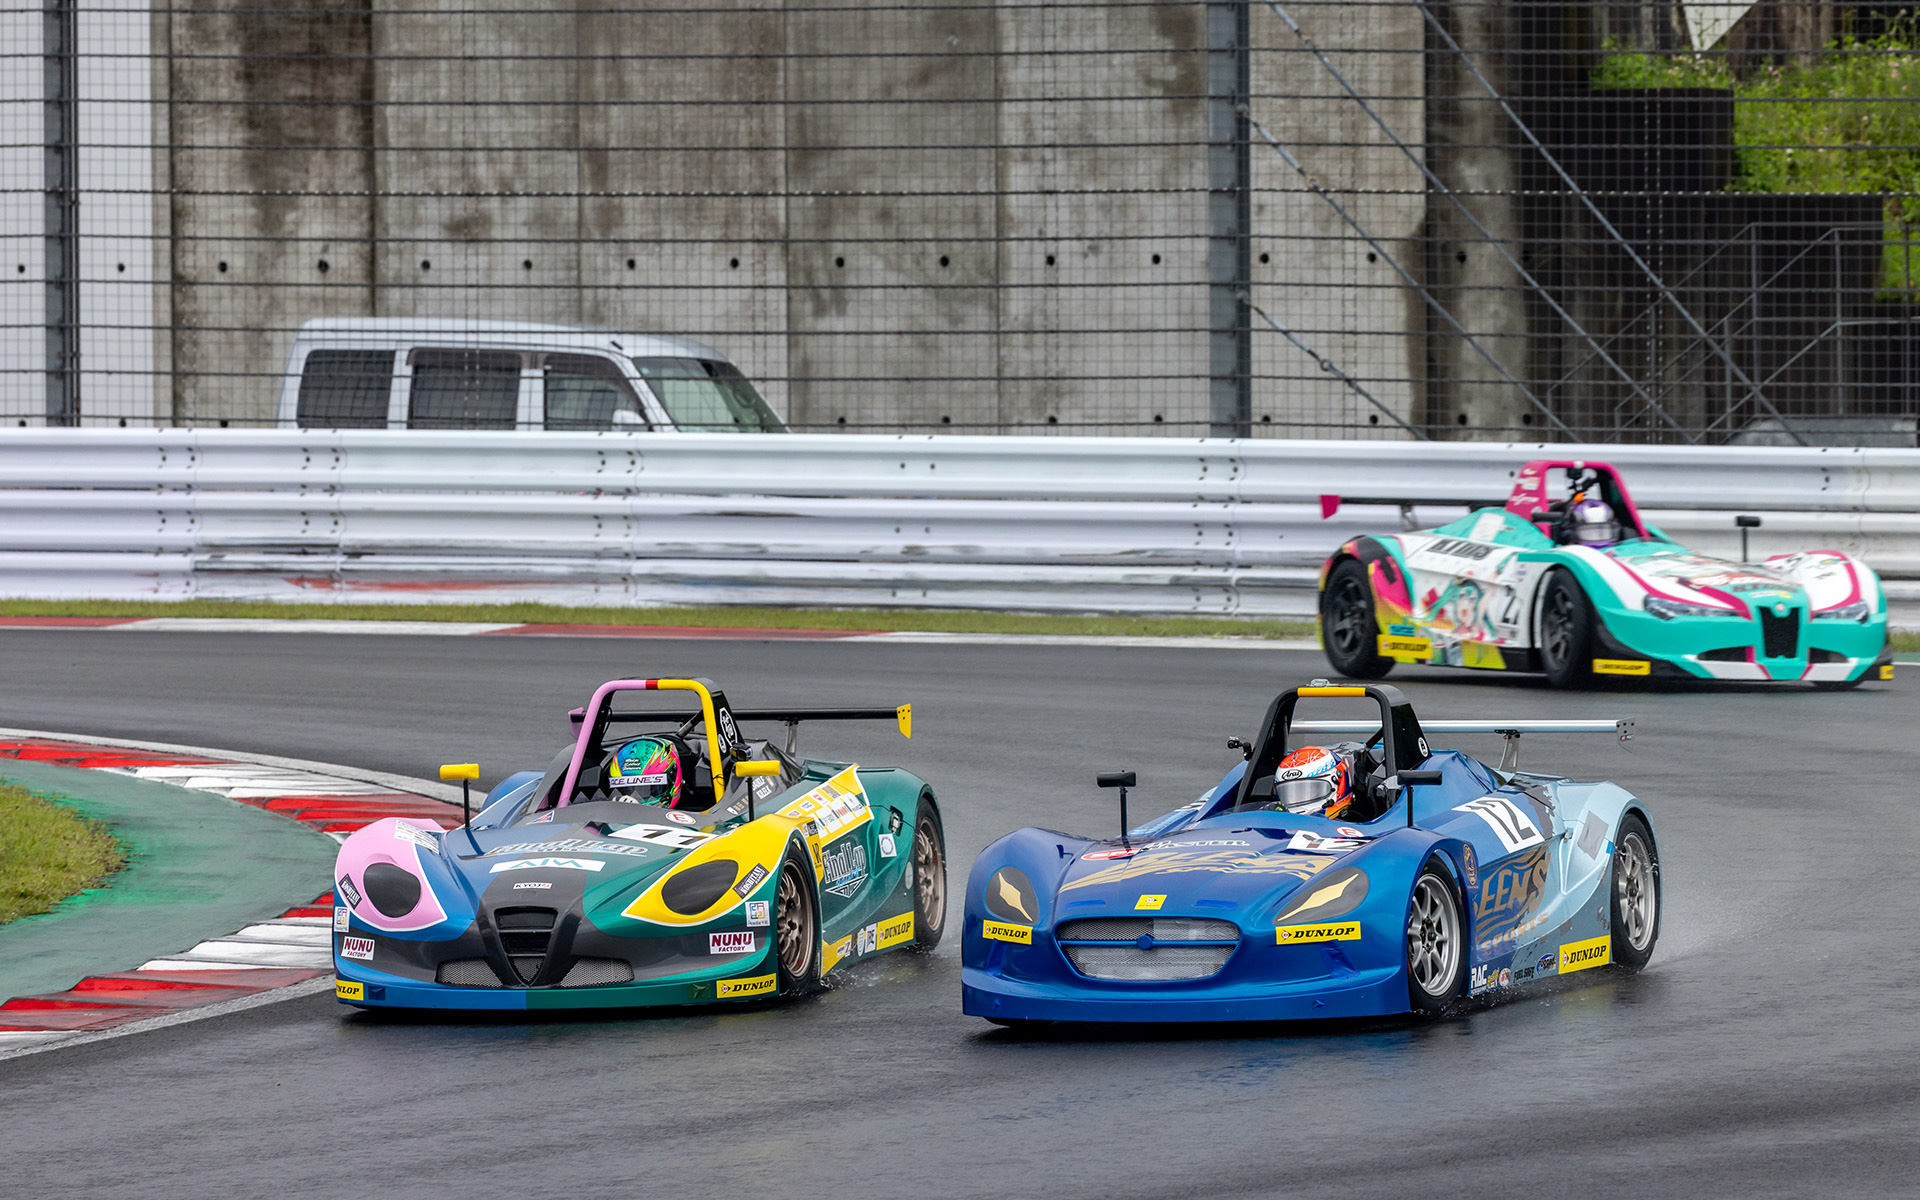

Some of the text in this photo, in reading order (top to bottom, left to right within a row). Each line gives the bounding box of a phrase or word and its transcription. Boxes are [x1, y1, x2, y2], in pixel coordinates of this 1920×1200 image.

[1465, 800, 1536, 845] 12
[1474, 852, 1551, 921] EENS
[884, 921, 911, 940] DUNLOP
[990, 926, 1028, 939] DUNLOP
[1293, 926, 1355, 939] DUNLOP
[1480, 912, 1549, 951] SPORTS
[344, 938, 374, 952] NUNU
[711, 933, 752, 947] NUNU
[1569, 945, 1607, 963] DUNLOP
[336, 984, 360, 995] NLOP
[732, 980, 774, 992] DUNLOP
